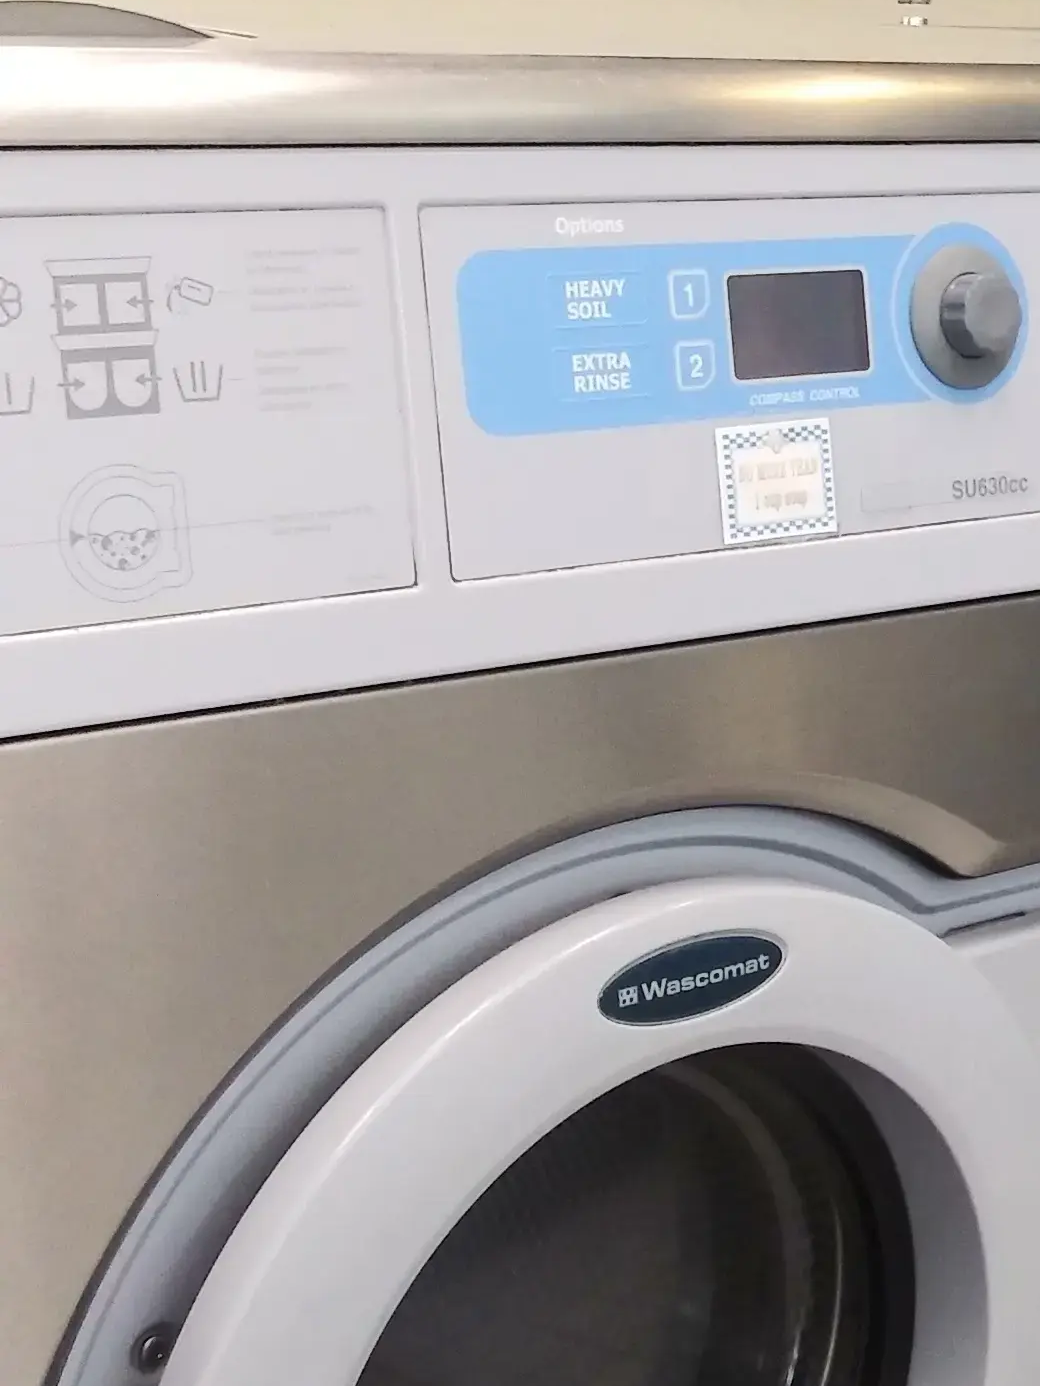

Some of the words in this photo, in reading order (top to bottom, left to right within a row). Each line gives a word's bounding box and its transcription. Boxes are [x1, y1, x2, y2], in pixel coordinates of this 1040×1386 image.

[554, 216, 625, 238] Options
[565, 278, 626, 299] HEAVY
[683, 282, 695, 308] 1
[567, 301, 612, 320] SOIL
[572, 351, 632, 373] EXTRA
[689, 353, 704, 379] 2
[574, 372, 632, 393] RINSE
[749, 390, 806, 407] COMPASS
[809, 386, 861, 402] CONTROL
[952, 475, 1028, 500] SU630cc
[641, 953, 770, 1001] Wascomat
